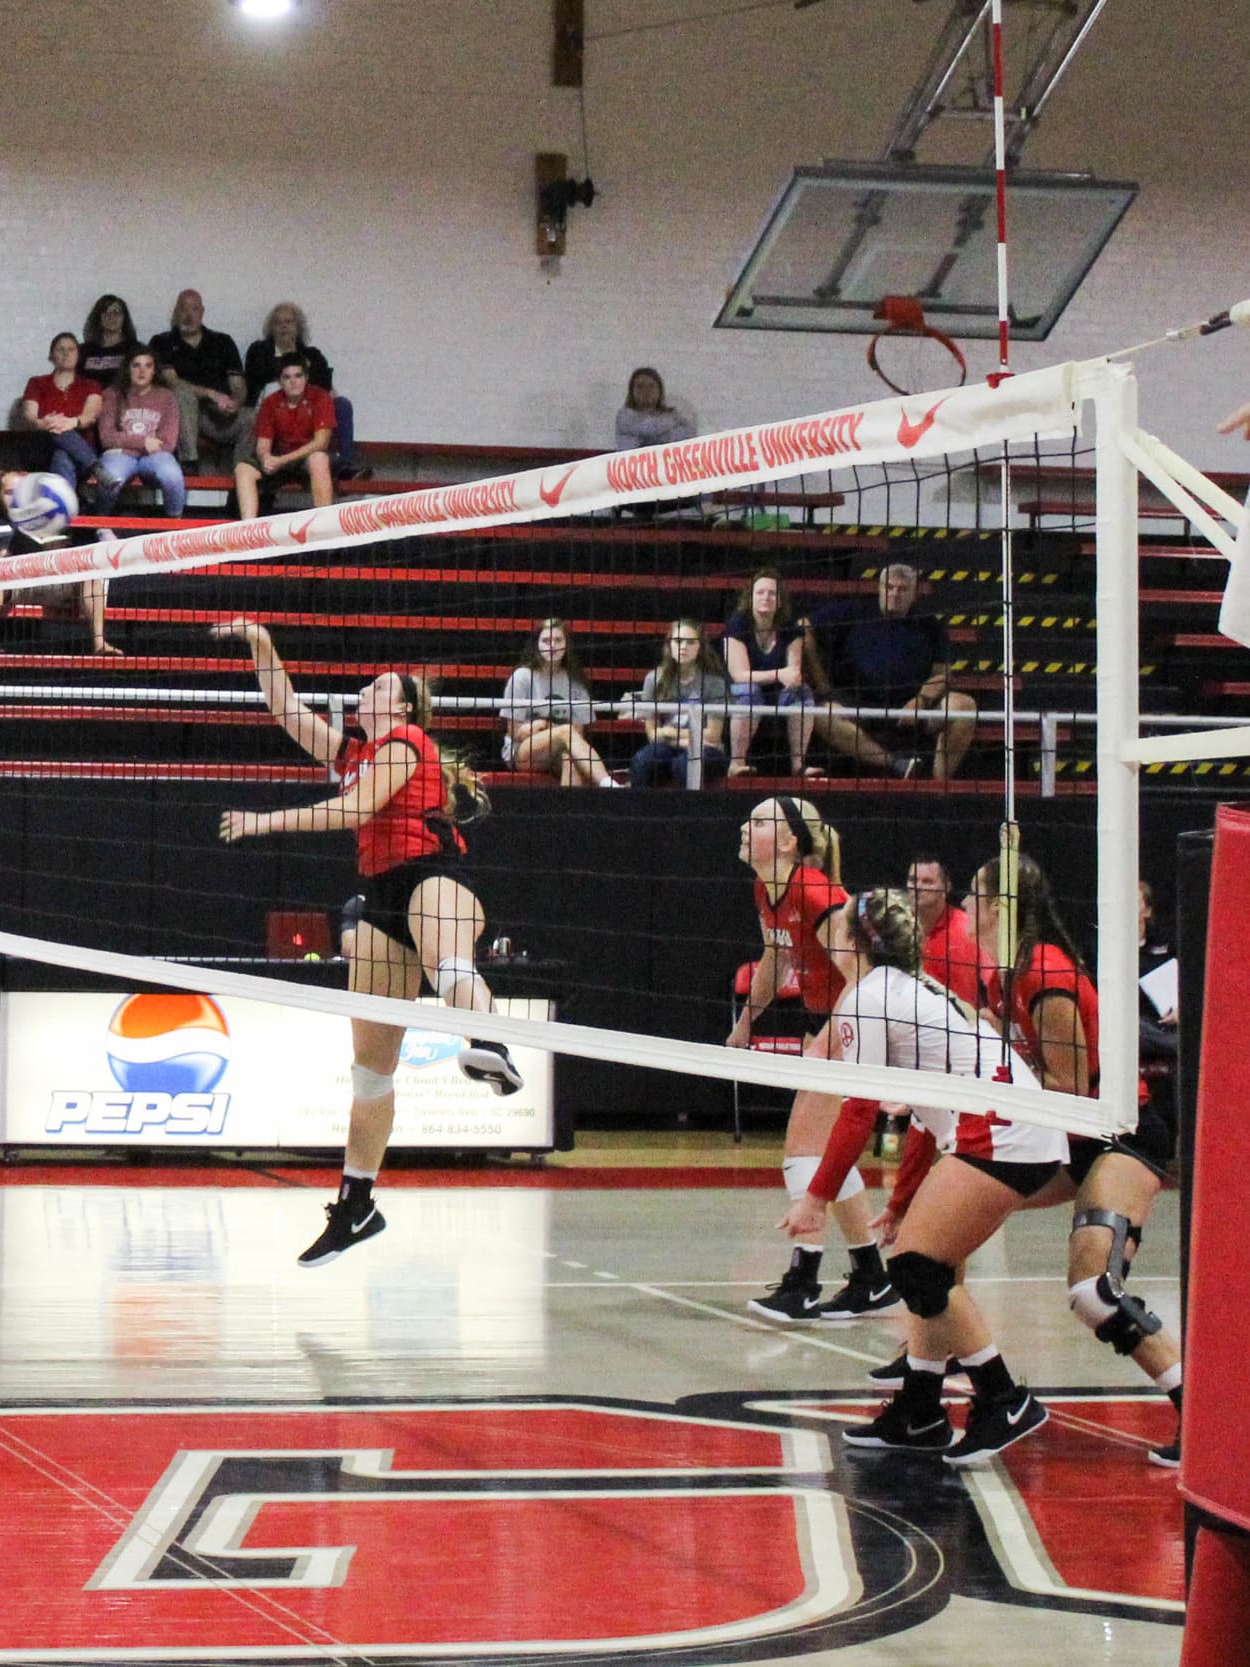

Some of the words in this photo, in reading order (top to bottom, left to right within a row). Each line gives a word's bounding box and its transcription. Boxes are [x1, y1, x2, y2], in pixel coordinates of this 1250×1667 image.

[607, 450, 662, 493] NORTH
[663, 432, 760, 486] GREENVILLE
[759, 412, 864, 468] UNIVERSITY
[339, 504, 382, 536] NORTH
[443, 479, 521, 519] UNIVERSITY
[45, 1090, 231, 1134] PEPSI
